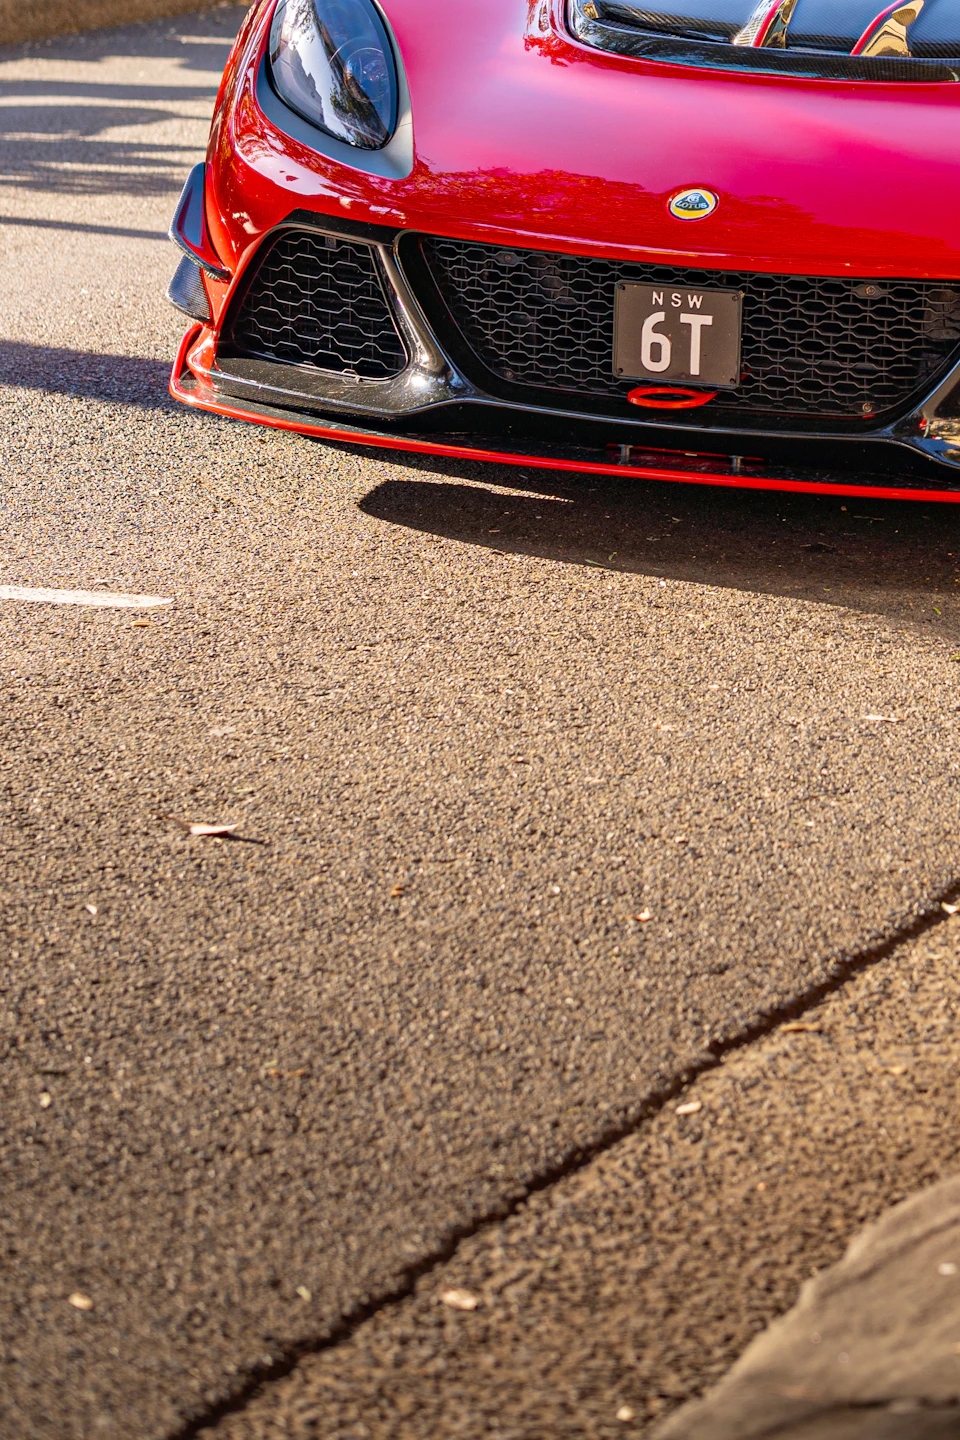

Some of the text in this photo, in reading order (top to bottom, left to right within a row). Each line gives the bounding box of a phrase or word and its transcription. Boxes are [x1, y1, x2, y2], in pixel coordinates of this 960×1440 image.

[676, 201, 708, 209] LOTUS
[652, 291, 703, 309] NSW
[641, 311, 713, 376] 6T
